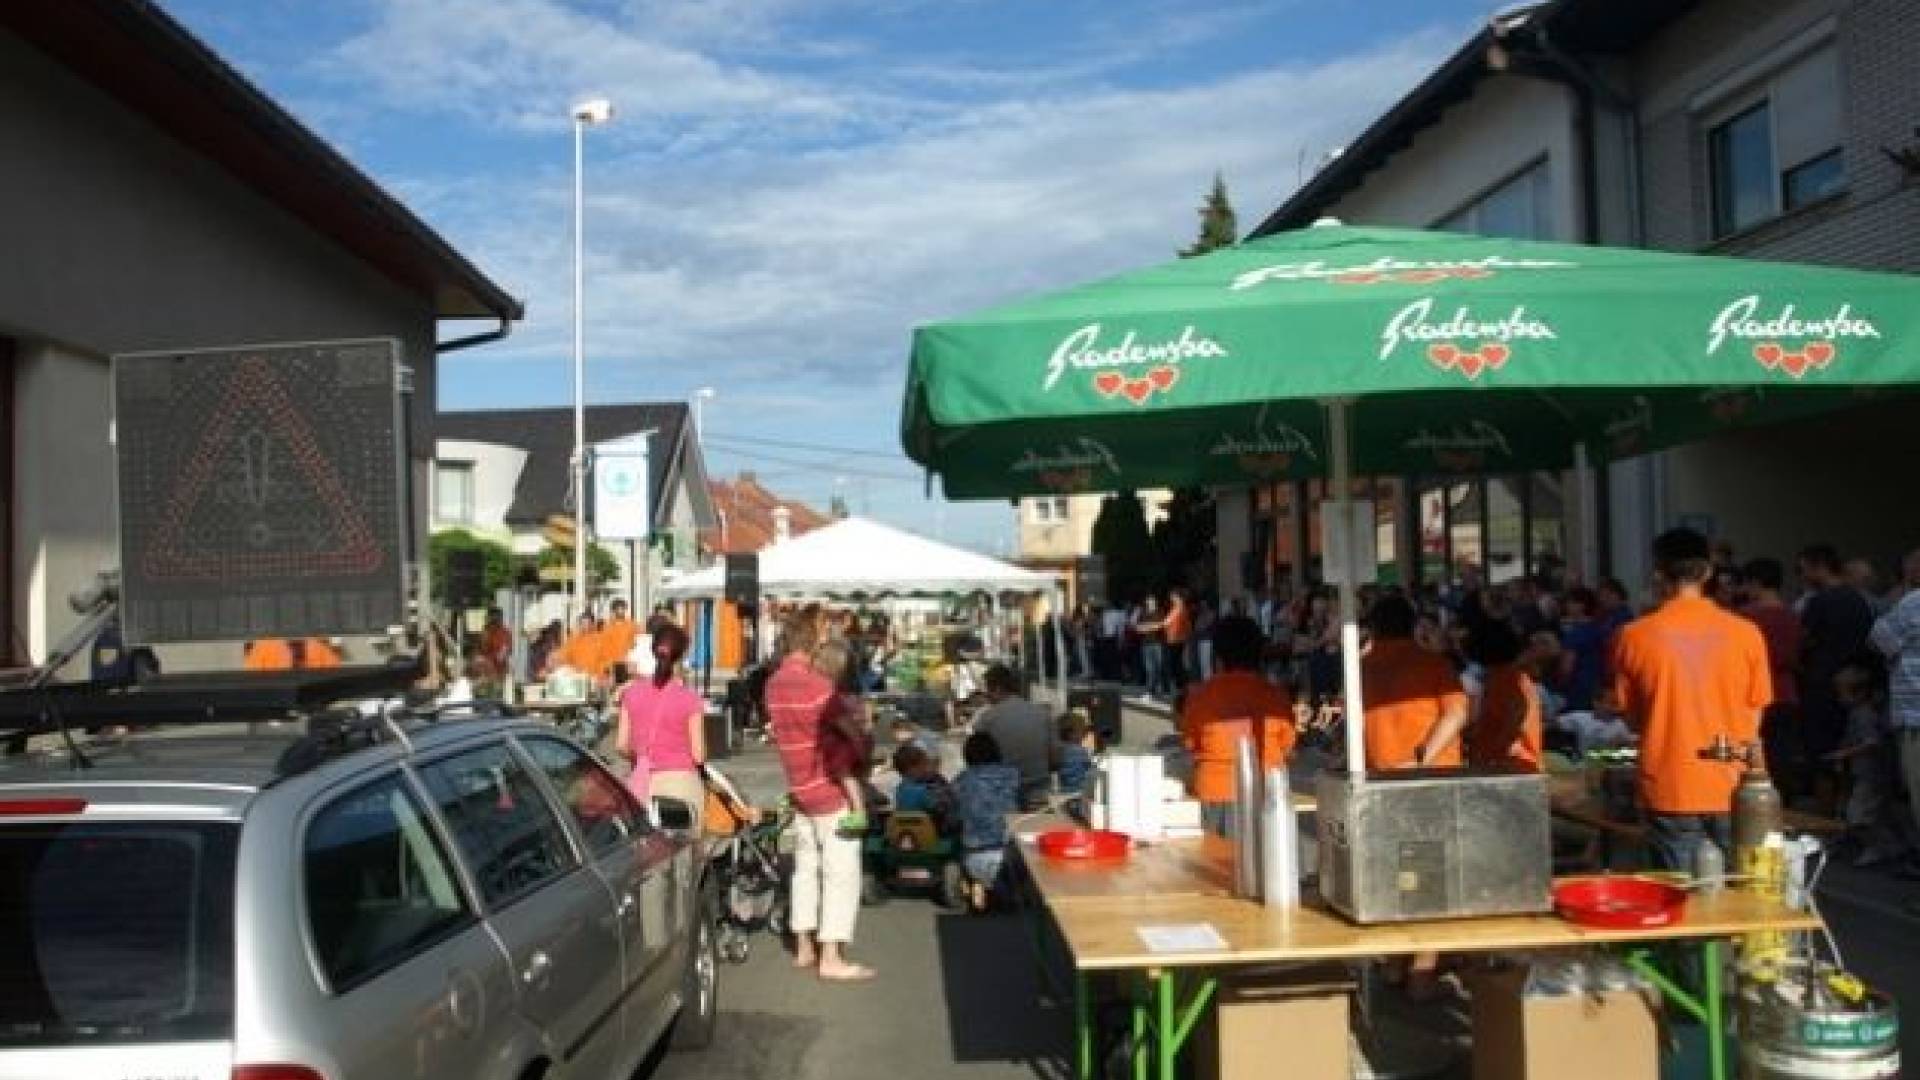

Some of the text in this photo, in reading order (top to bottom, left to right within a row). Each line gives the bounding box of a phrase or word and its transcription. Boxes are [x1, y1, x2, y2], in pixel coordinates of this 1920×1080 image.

[1042, 322, 1228, 393] Radenska
[1379, 296, 1558, 361] Radenska
[1706, 294, 1882, 356] Radenska
